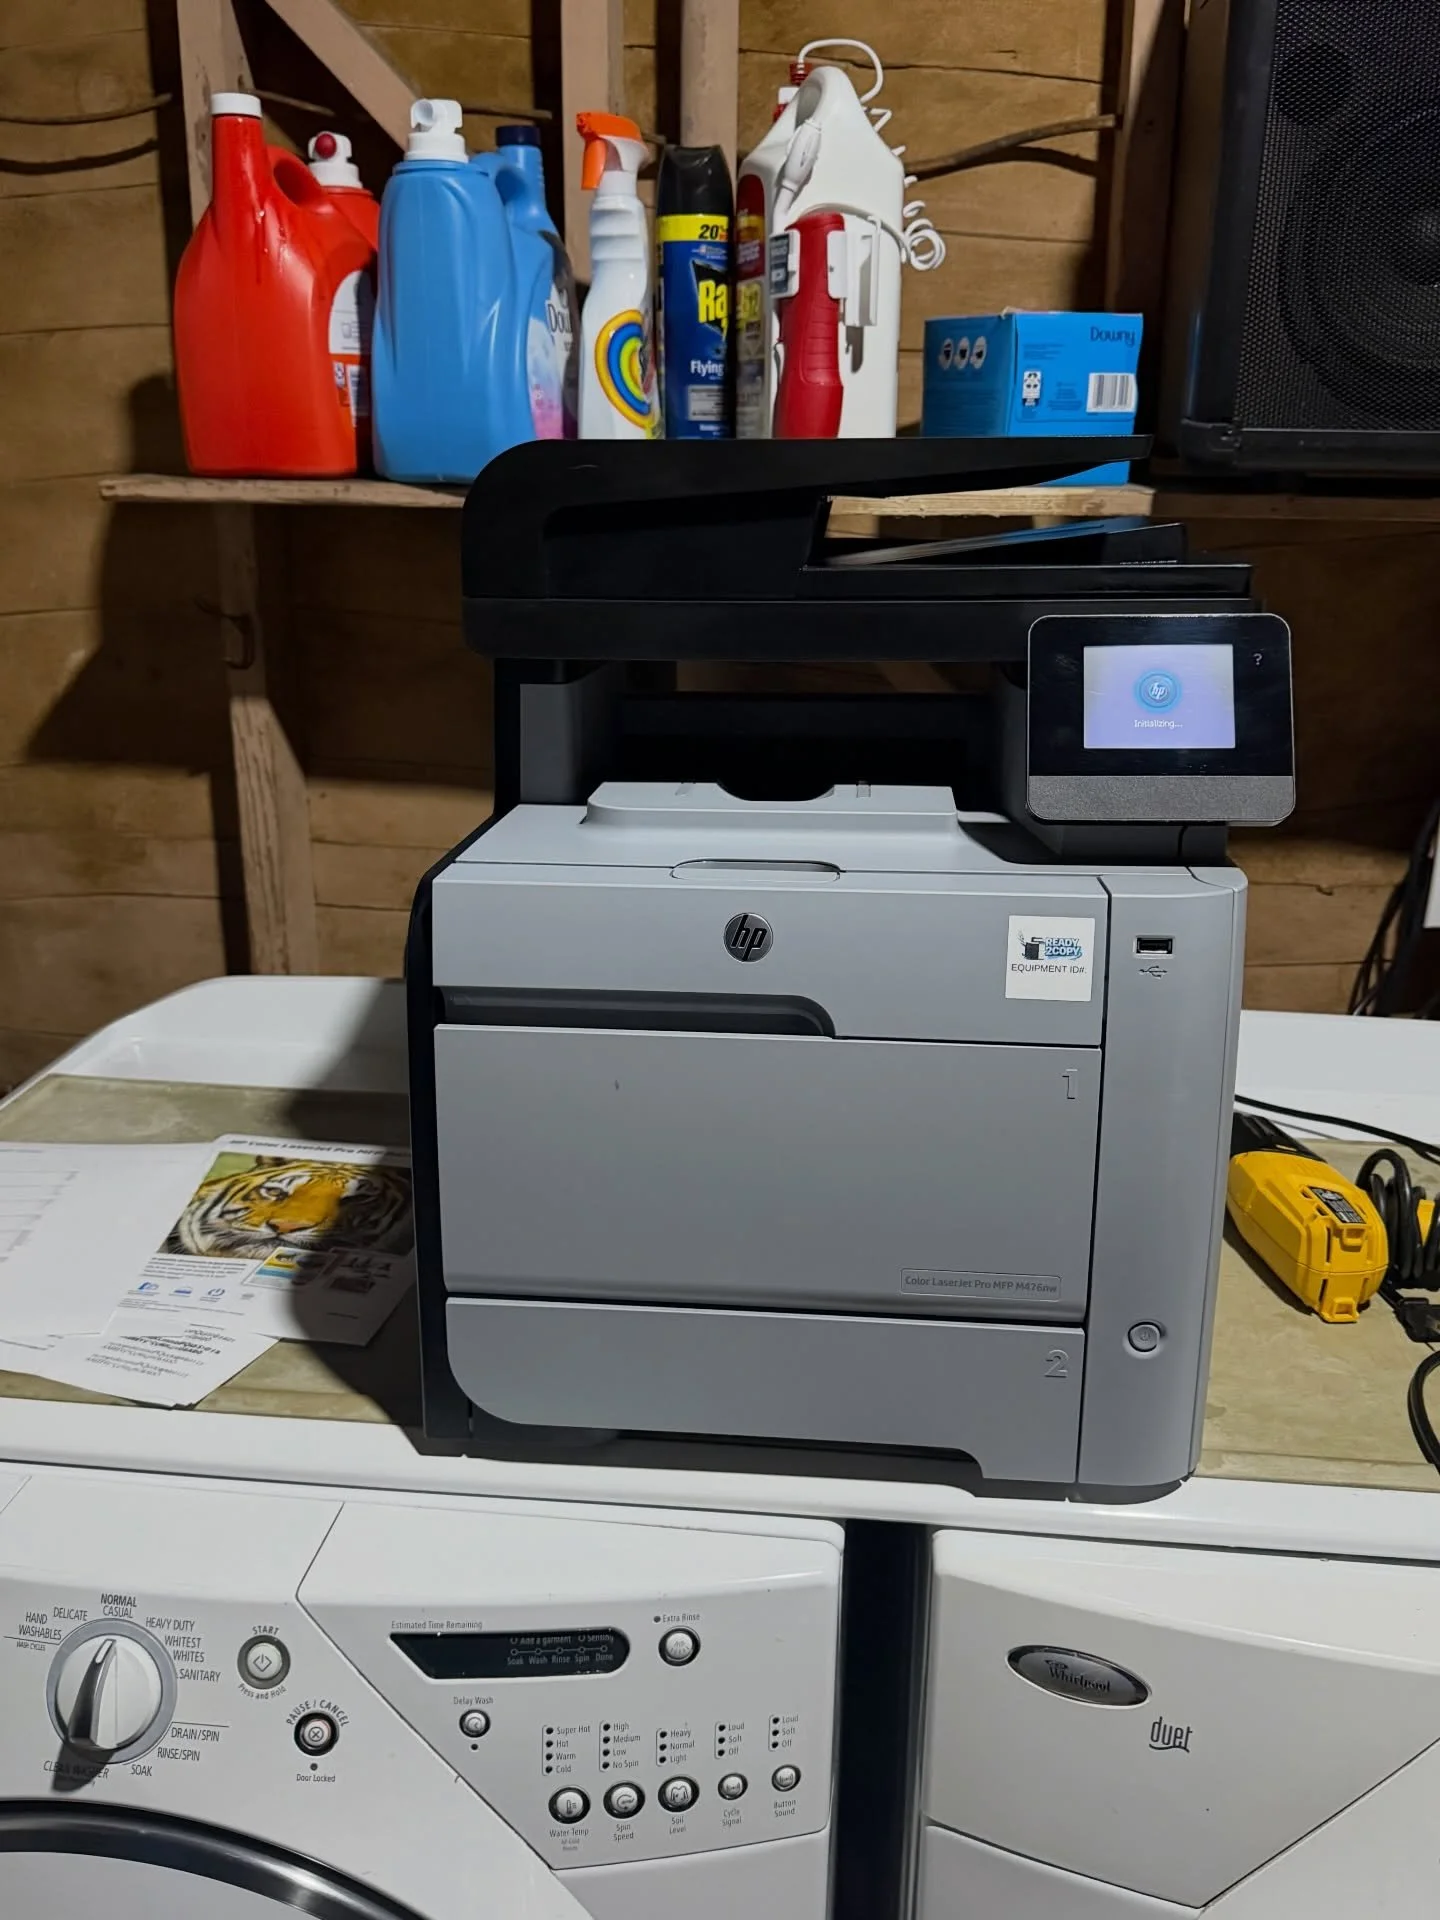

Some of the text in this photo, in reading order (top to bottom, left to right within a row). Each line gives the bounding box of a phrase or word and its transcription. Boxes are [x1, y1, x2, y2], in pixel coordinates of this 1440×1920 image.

[1089, 326, 1136, 348] Downy
[1134, 719, 1183, 730] Initializing...
[731, 914, 768, 962] hp
[1045, 937, 1080, 947] READY
[1045, 947, 1081, 956] 2COPY
[1011, 963, 1067, 973] EQUIPMENT
[1062, 1068, 1078, 1100] 1
[905, 1275, 930, 1286] Color
[932, 1278, 972, 1288] LaserJet
[974, 1280, 991, 1289] Pro
[993, 1281, 1014, 1290] MFP
[1044, 1349, 1069, 1378] 2
[100, 1593, 137, 1607] NORMAL
[53, 1606, 88, 1621] DELICATE
[102, 1605, 133, 1618] CASUAL
[25, 1611, 48, 1624] HAND
[662, 1613, 700, 1623] Extra Rinse
[145, 1617, 195, 1632] HEAVY DUTY
[391, 1621, 483, 1630] Estimated Time Remaining
[19, 1624, 62, 1640] WASHABLES
[252, 1625, 279, 1636] START
[164, 1635, 202, 1649] WHITEST
[542, 1635, 572, 1646] garment
[587, 1634, 614, 1643] Sensing
[30, 1642, 46, 1651] CYCLES
[173, 1649, 205, 1662] WHITES
[528, 1656, 548, 1665] Wash
[552, 1655, 571, 1664] Rinse
[575, 1654, 590, 1665] Spin
[595, 1653, 614, 1662] Done
[507, 1657, 524, 1666] Soak
[179, 1668, 221, 1682] SANITARY
[1048, 1667, 1111, 1692] Whirlpool
[238, 1683, 287, 1700] Press and Hold
[453, 1696, 494, 1706] Delay Wash
[286, 1700, 311, 1726] PAUSE
[319, 1699, 350, 1727] CANCEL
[782, 1715, 799, 1723] Loud
[557, 1725, 591, 1736] Super Hot
[613, 1723, 630, 1732] High
[728, 1723, 744, 1731] Loud
[782, 1727, 796, 1735] Soft
[171, 1727, 220, 1742] DRAIN/SPIN
[670, 1729, 691, 1738] Heavy
[1150, 1716, 1193, 1750] duet
[556, 1740, 569, 1748] Hot
[613, 1735, 641, 1743] Medium
[728, 1735, 742, 1743] Soft
[670, 1741, 695, 1750] Normal
[157, 1747, 200, 1761] RINSE/SPIN
[613, 1748, 627, 1756] Low
[728, 1747, 739, 1755] Off
[556, 1753, 576, 1761] Warm
[670, 1755, 687, 1764] Light
[556, 1765, 572, 1773] Cold
[613, 1760, 639, 1769] No Spin
[130, 1764, 153, 1777] SOAK
[296, 1774, 336, 1783] Door Locked
[773, 1799, 797, 1809] Button
[723, 1808, 740, 1818] Cycle
[774, 1808, 795, 1817] Sound
[671, 1816, 684, 1824] Soil
[722, 1816, 742, 1827] Signal
[616, 1823, 631, 1832] Spin
[669, 1826, 687, 1835] Level
[549, 1828, 589, 1838] Water Temp
[613, 1832, 634, 1842] Speed
